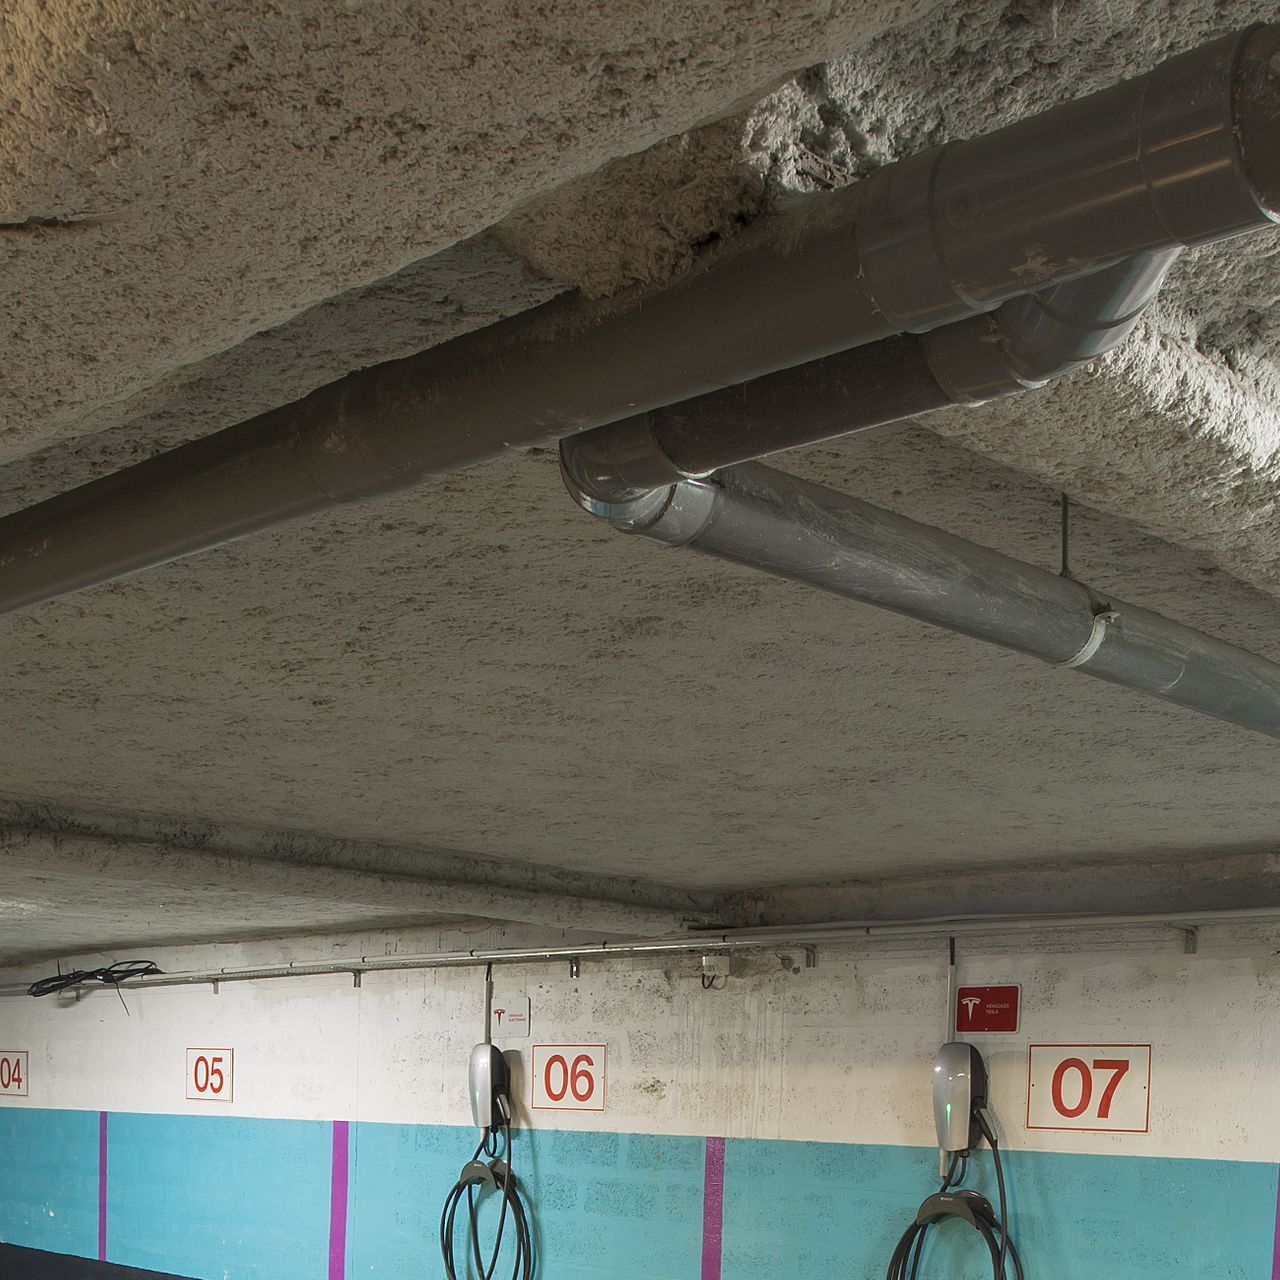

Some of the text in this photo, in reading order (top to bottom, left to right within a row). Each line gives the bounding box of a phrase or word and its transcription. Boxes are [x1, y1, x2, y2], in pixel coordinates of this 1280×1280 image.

[0, 1057, 23, 1089] 04
[194, 1056, 224, 1094] 05
[544, 1054, 595, 1102] 06
[1052, 1057, 1130, 1118] 07
